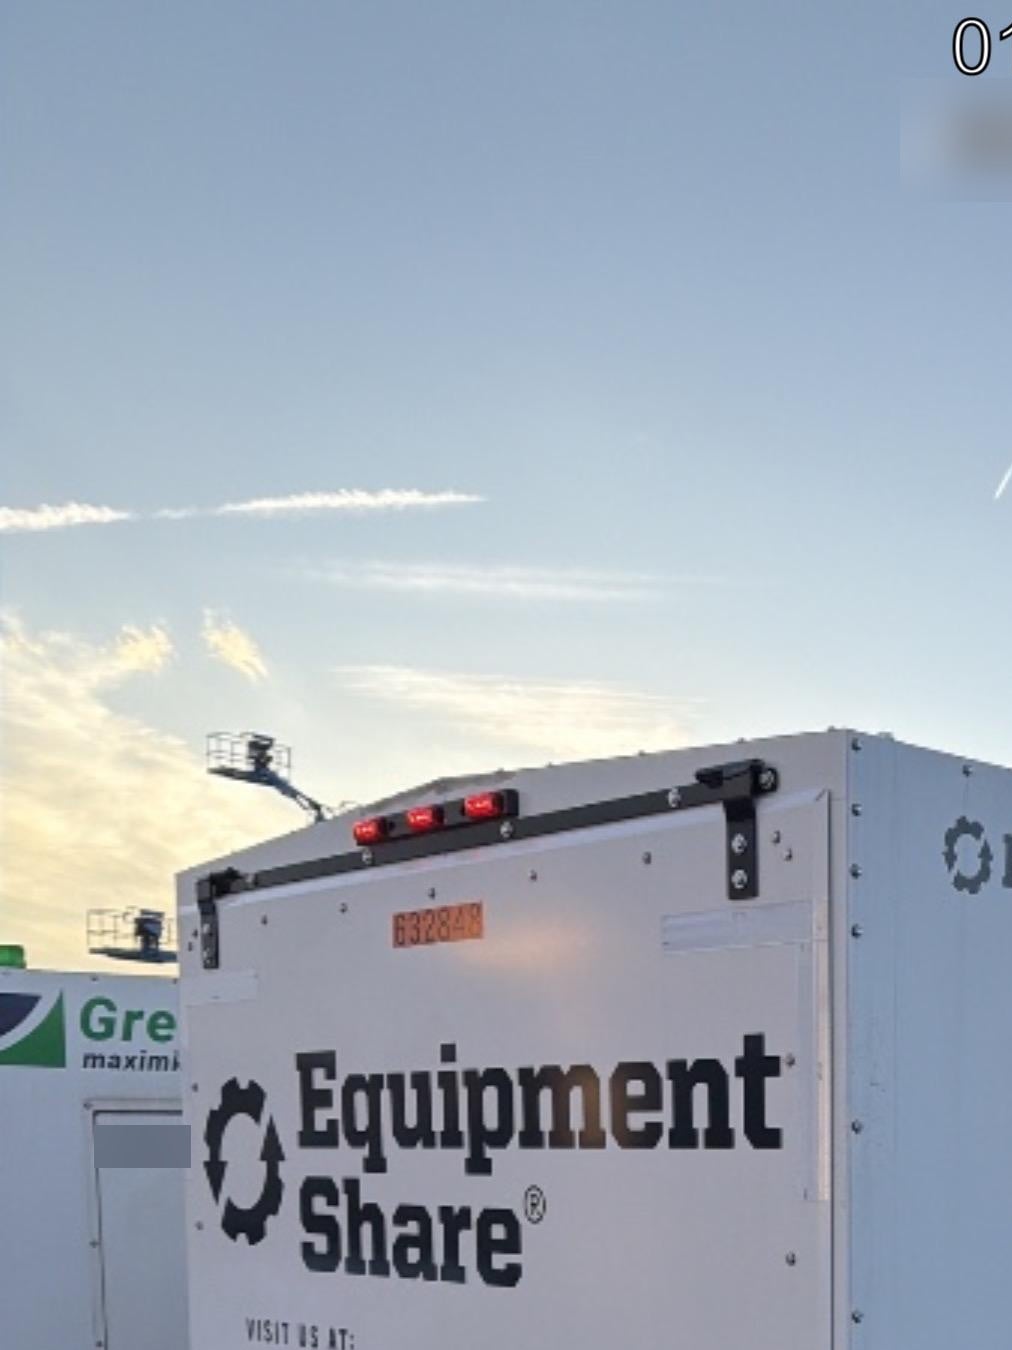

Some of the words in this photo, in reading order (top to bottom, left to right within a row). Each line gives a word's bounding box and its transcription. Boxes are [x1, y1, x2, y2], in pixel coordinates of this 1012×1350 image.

[83, 1051, 180, 1072] maximi
[296, 1032, 783, 1175] Equipment
[246, 1318, 289, 1345] VISIT
[298, 1324, 319, 1349] US
